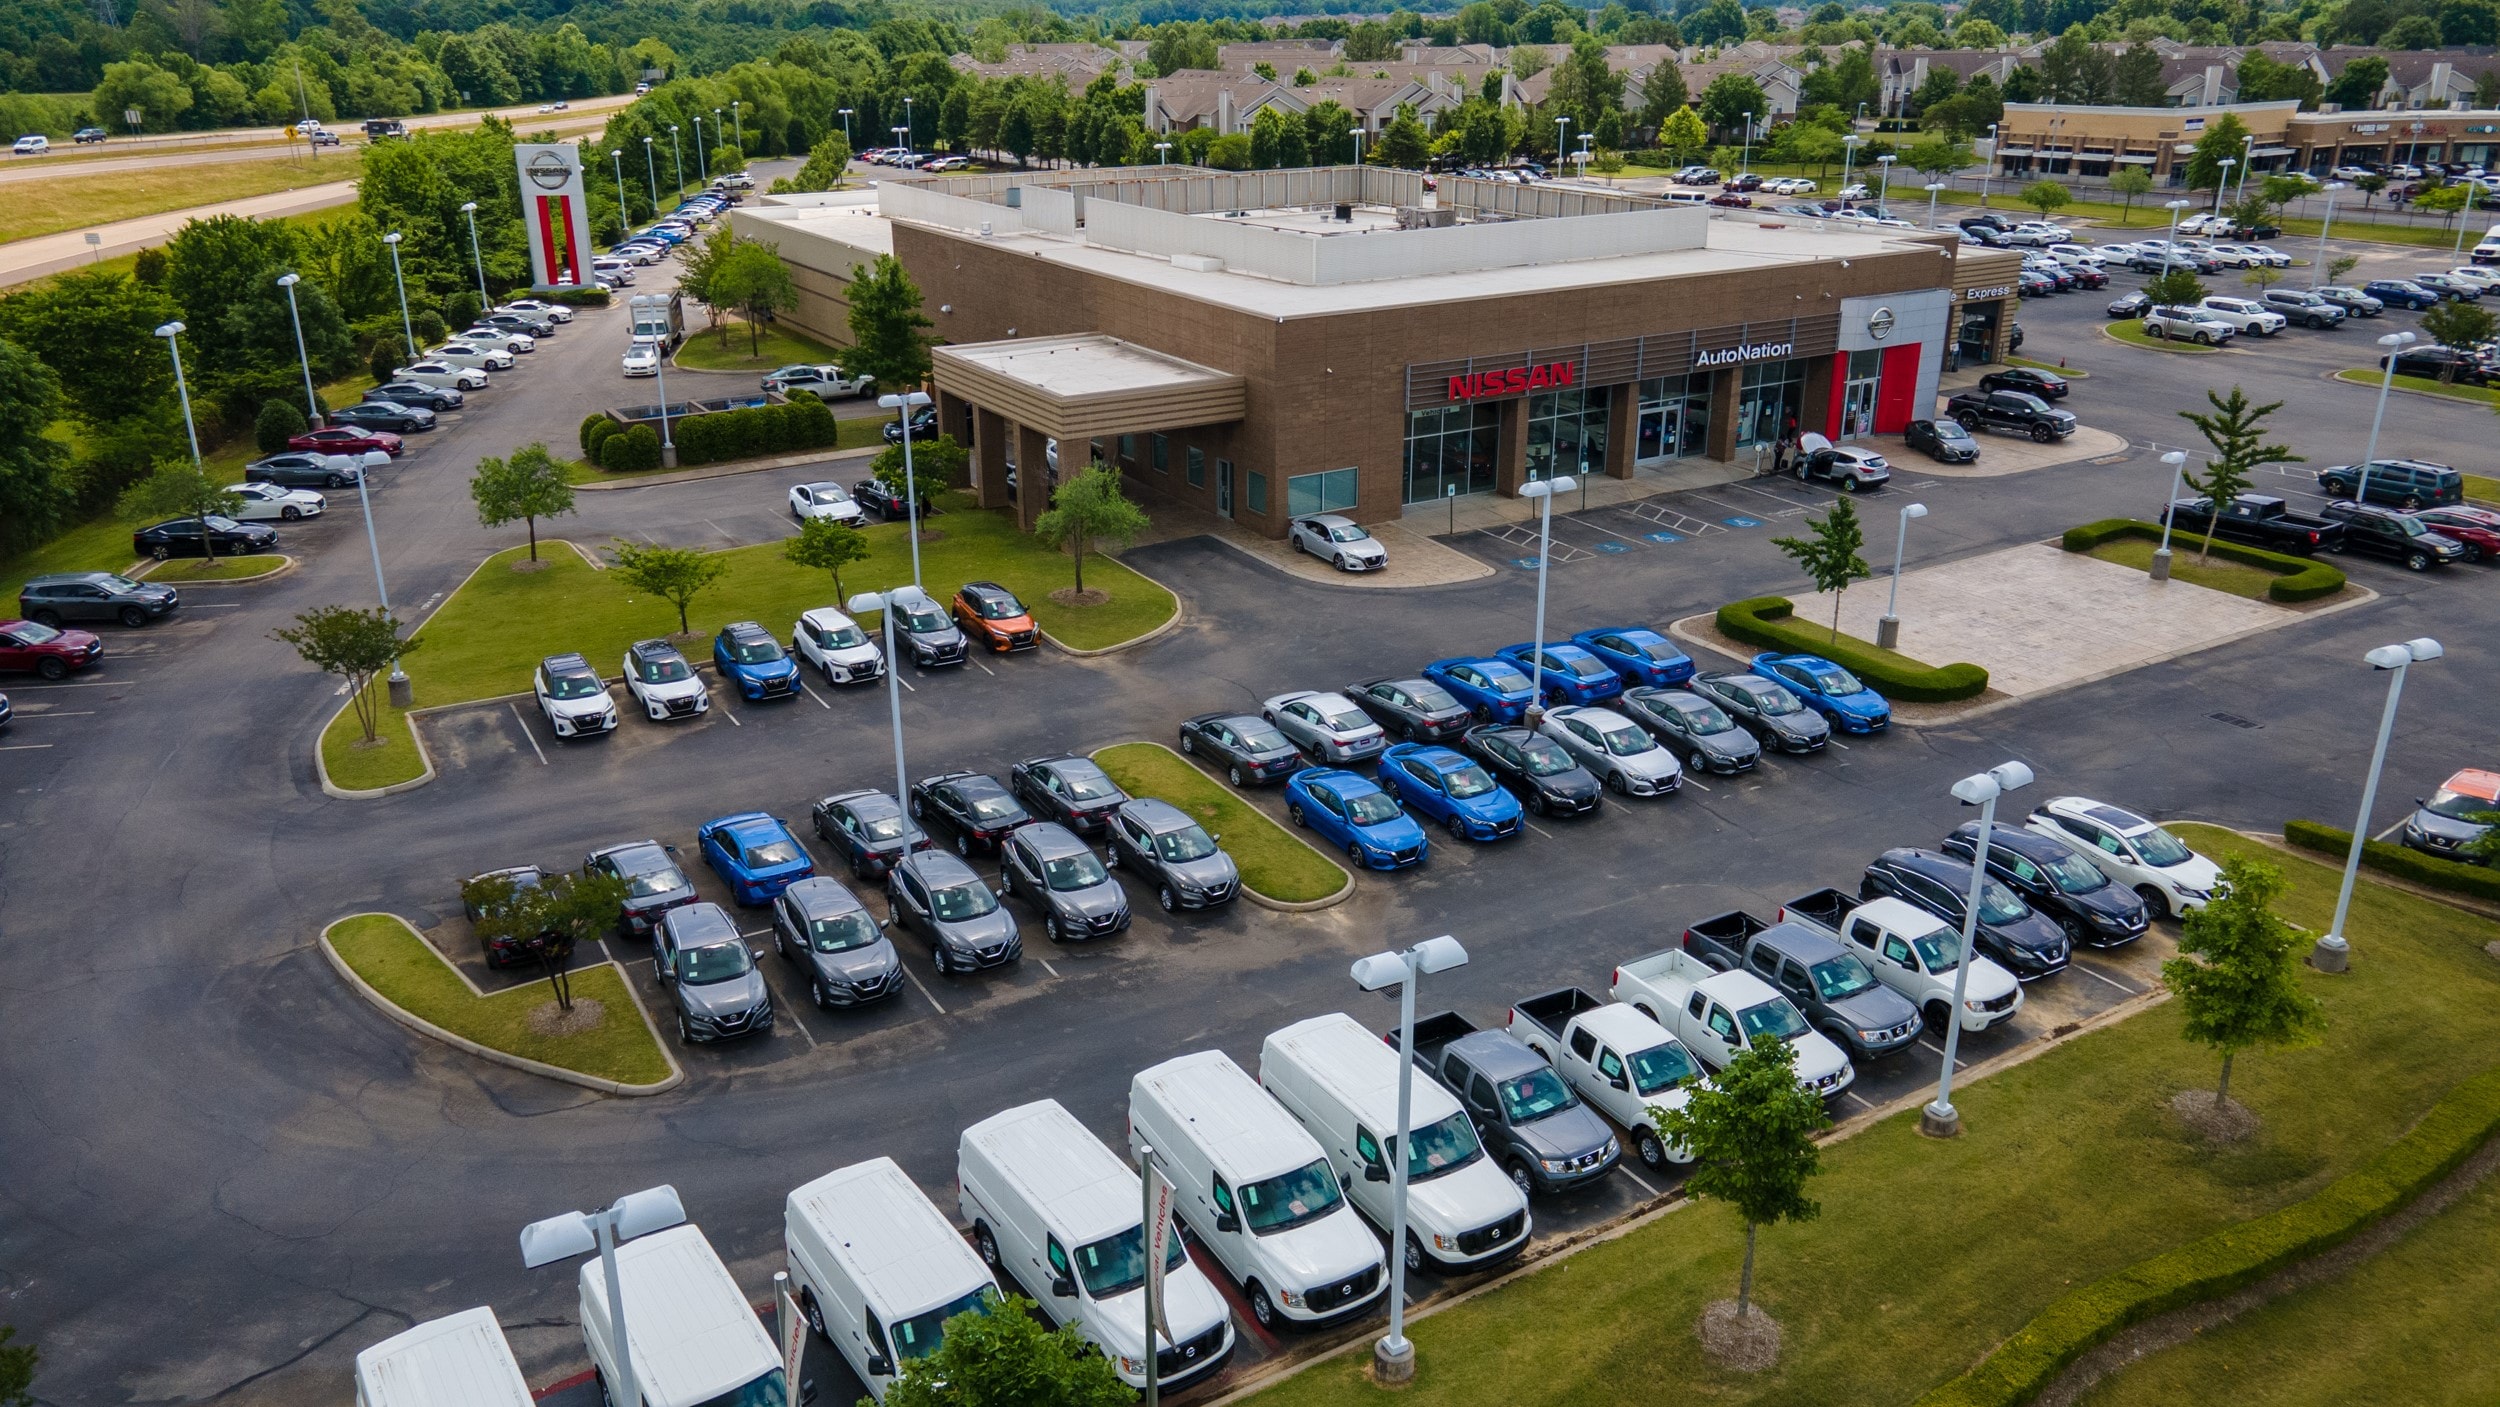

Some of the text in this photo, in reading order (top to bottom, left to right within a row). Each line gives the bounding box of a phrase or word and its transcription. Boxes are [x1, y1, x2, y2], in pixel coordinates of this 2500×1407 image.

[1967, 286, 2010, 301] Express
[1696, 342, 1792, 367] AutoNation
[1448, 361, 1574, 401] NISSAN
[1154, 1184, 1168, 1249] Vehicles
